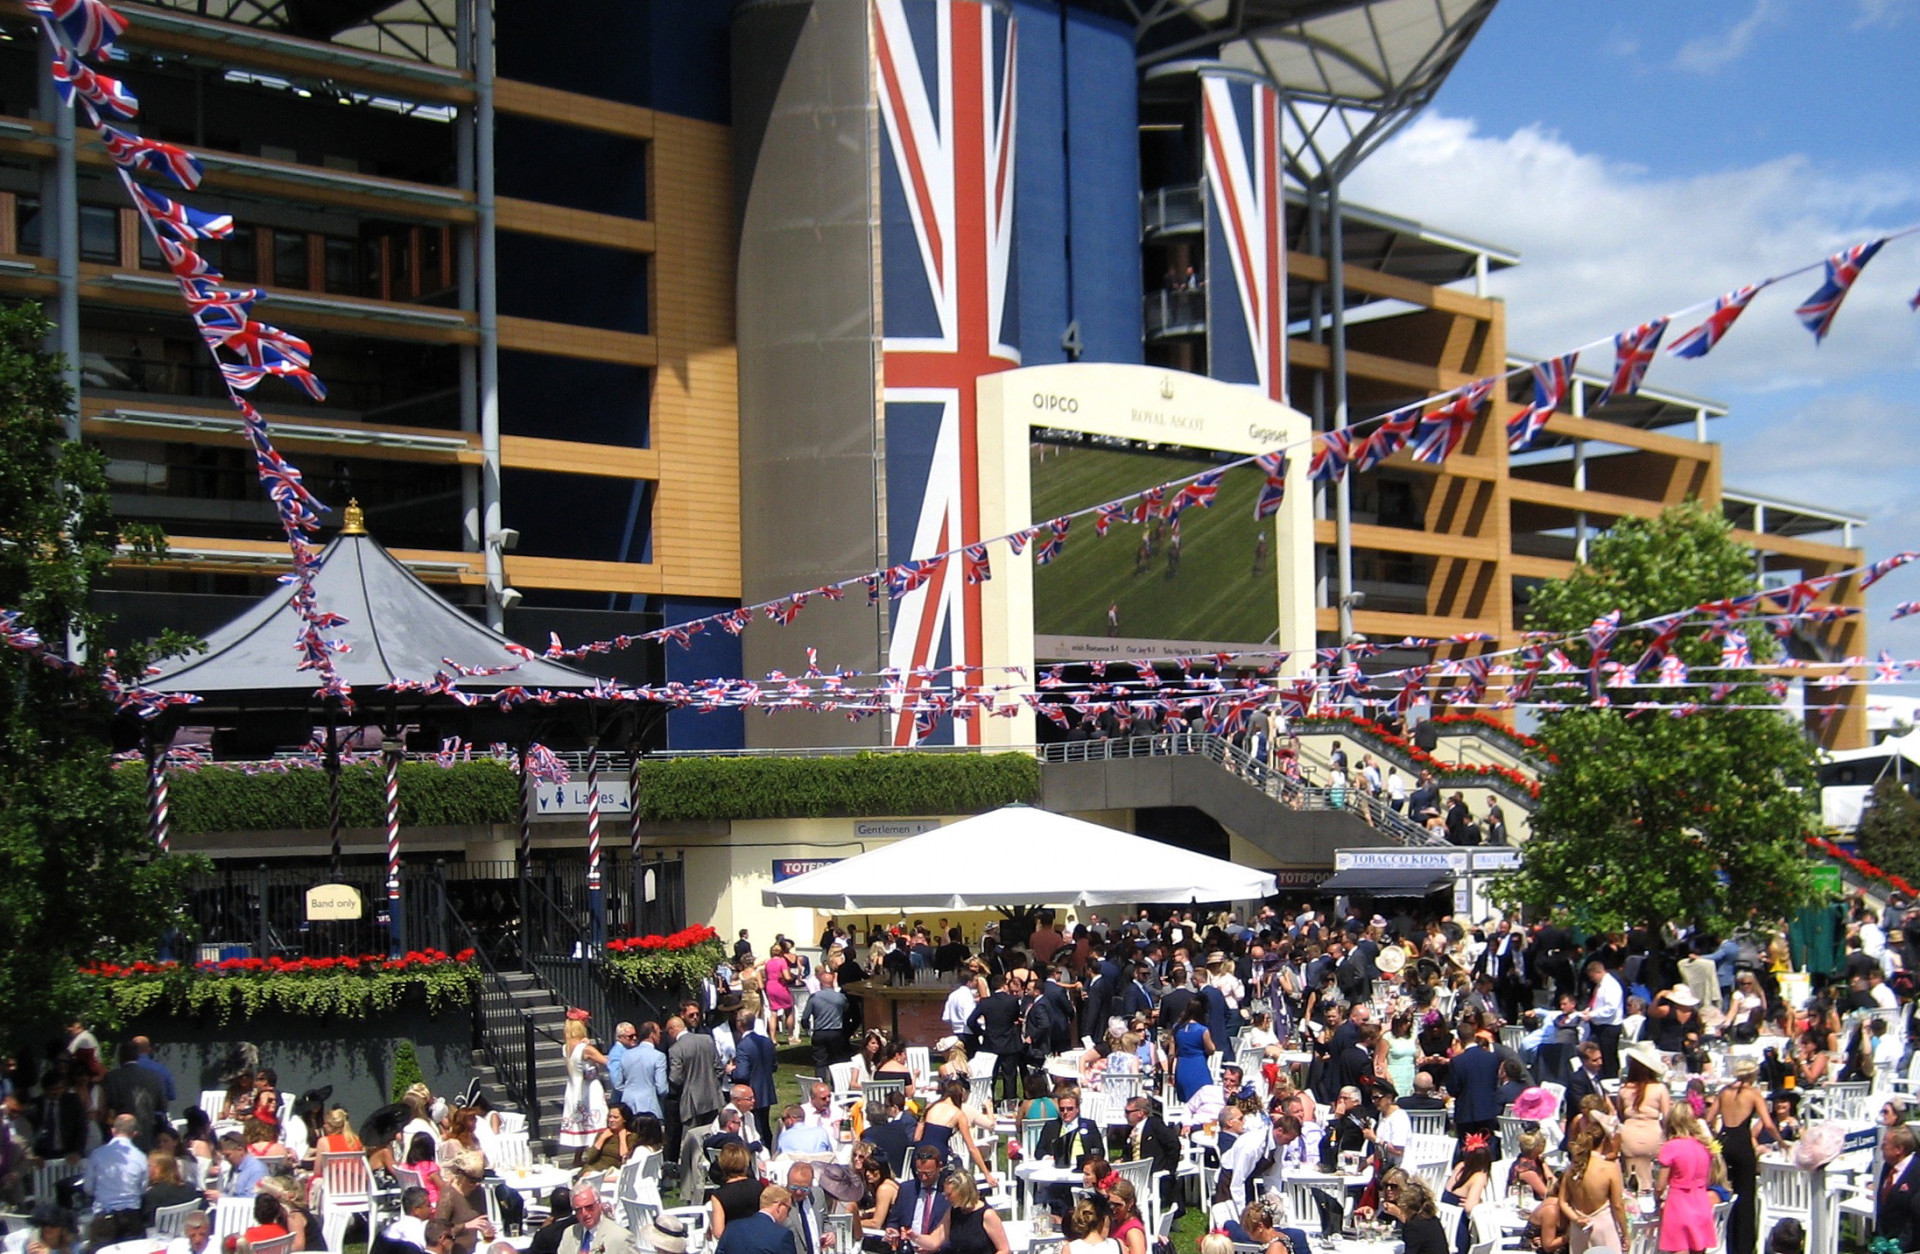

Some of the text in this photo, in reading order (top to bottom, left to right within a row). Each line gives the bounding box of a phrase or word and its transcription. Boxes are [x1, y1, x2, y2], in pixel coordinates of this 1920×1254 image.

[1131, 408, 1204, 431] ROYAL ASCOT
[575, 790, 614, 804] Laies
[858, 825, 910, 835] Gentlemen
[1353, 854, 1449, 864] TOBACCO KIOSK
[311, 898, 356, 910] Band only
